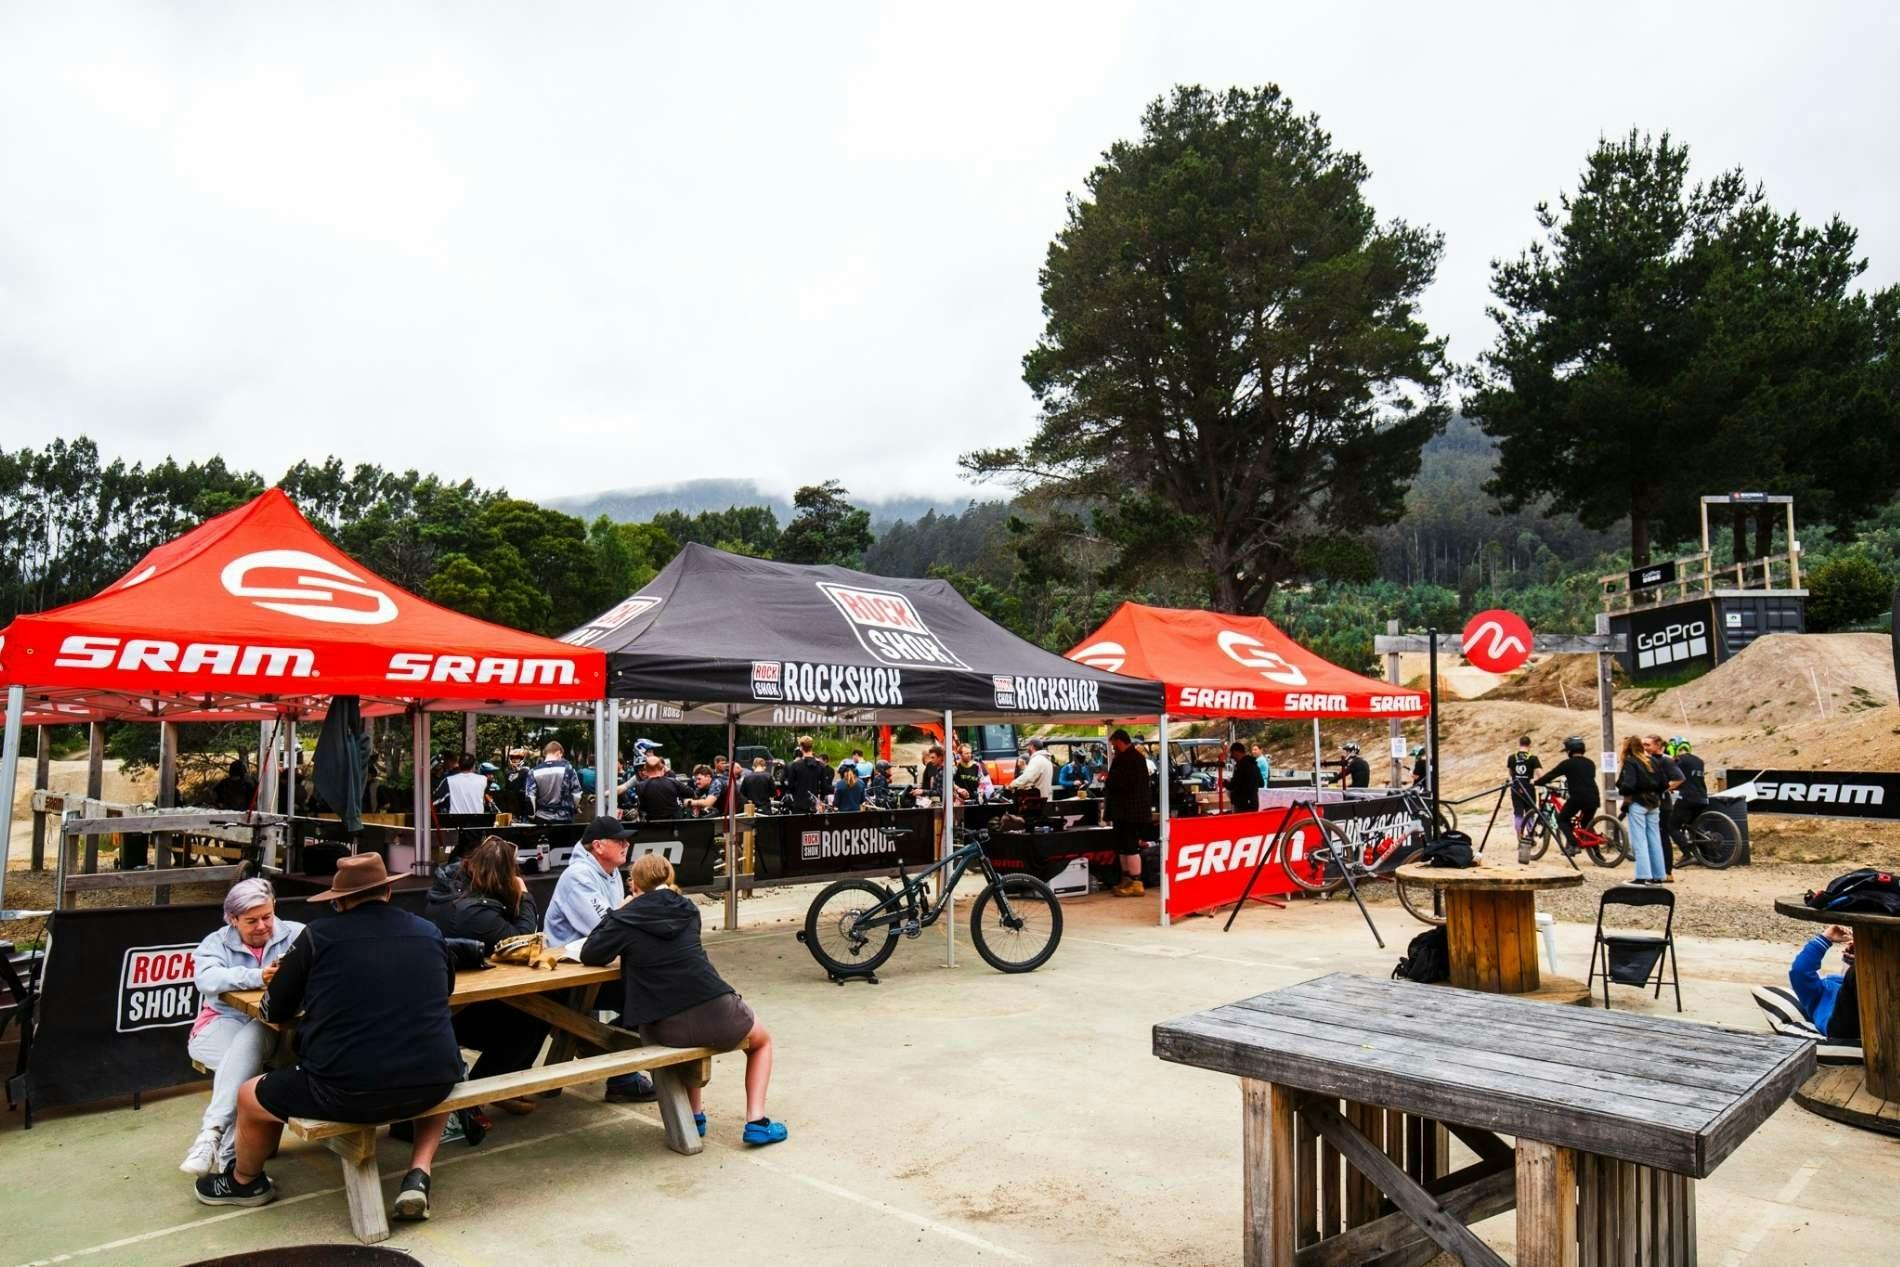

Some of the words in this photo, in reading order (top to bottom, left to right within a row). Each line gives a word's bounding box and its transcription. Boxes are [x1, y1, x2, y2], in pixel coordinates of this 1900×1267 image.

[837, 591, 919, 630] ROCK
[868, 629, 954, 664] SHOX
[1637, 621, 1705, 650] GoPro
[54, 635, 316, 677] SRAM
[385, 652, 576, 685] SRAM
[755, 664, 778, 680] ROCK
[755, 681, 780, 697] SHOX
[784, 662, 903, 706] ROCKSHOX
[1015, 676, 1100, 712] ROCKSHOX
[1179, 687, 1255, 710] SRAM
[1284, 693, 1348, 712] SRAM
[1370, 695, 1422, 712] SRAM
[1754, 782, 1885, 805] SRAM
[1175, 830, 1305, 882] SRAM
[132, 953, 195, 984] ROCK
[129, 987, 193, 1022] SHOX
